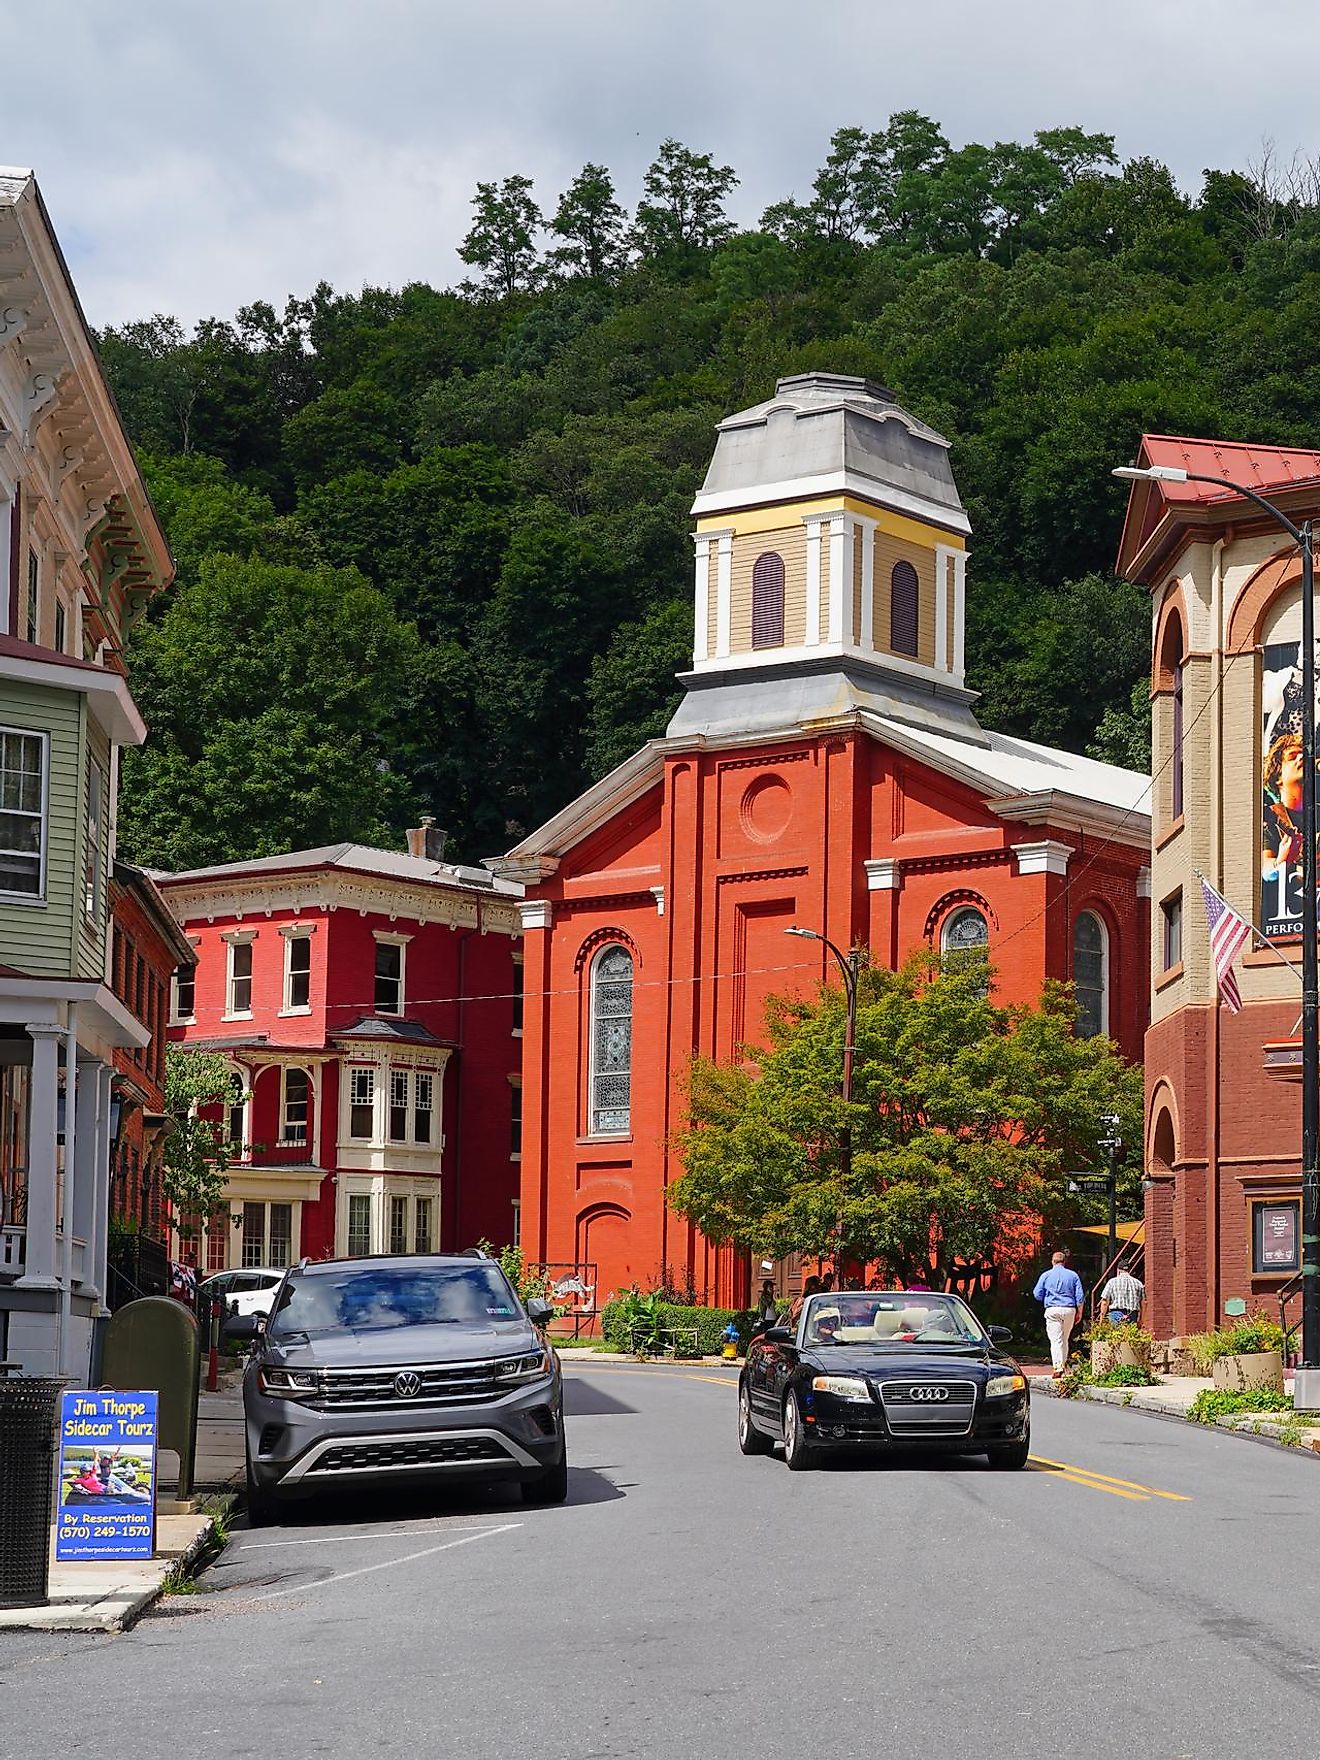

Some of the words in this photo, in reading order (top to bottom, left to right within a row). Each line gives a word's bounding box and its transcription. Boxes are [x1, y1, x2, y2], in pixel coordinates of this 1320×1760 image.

[73, 1398, 97, 1416] Jim
[101, 1398, 146, 1420] Thorpe
[64, 1419, 113, 1436] Sidecar
[117, 1419, 154, 1436] Tourz
[64, 1513, 78, 1525] By
[82, 1513, 147, 1523] Reservation
[59, 1526, 90, 1539] (570)
[94, 1526, 151, 1537] 249-1570
